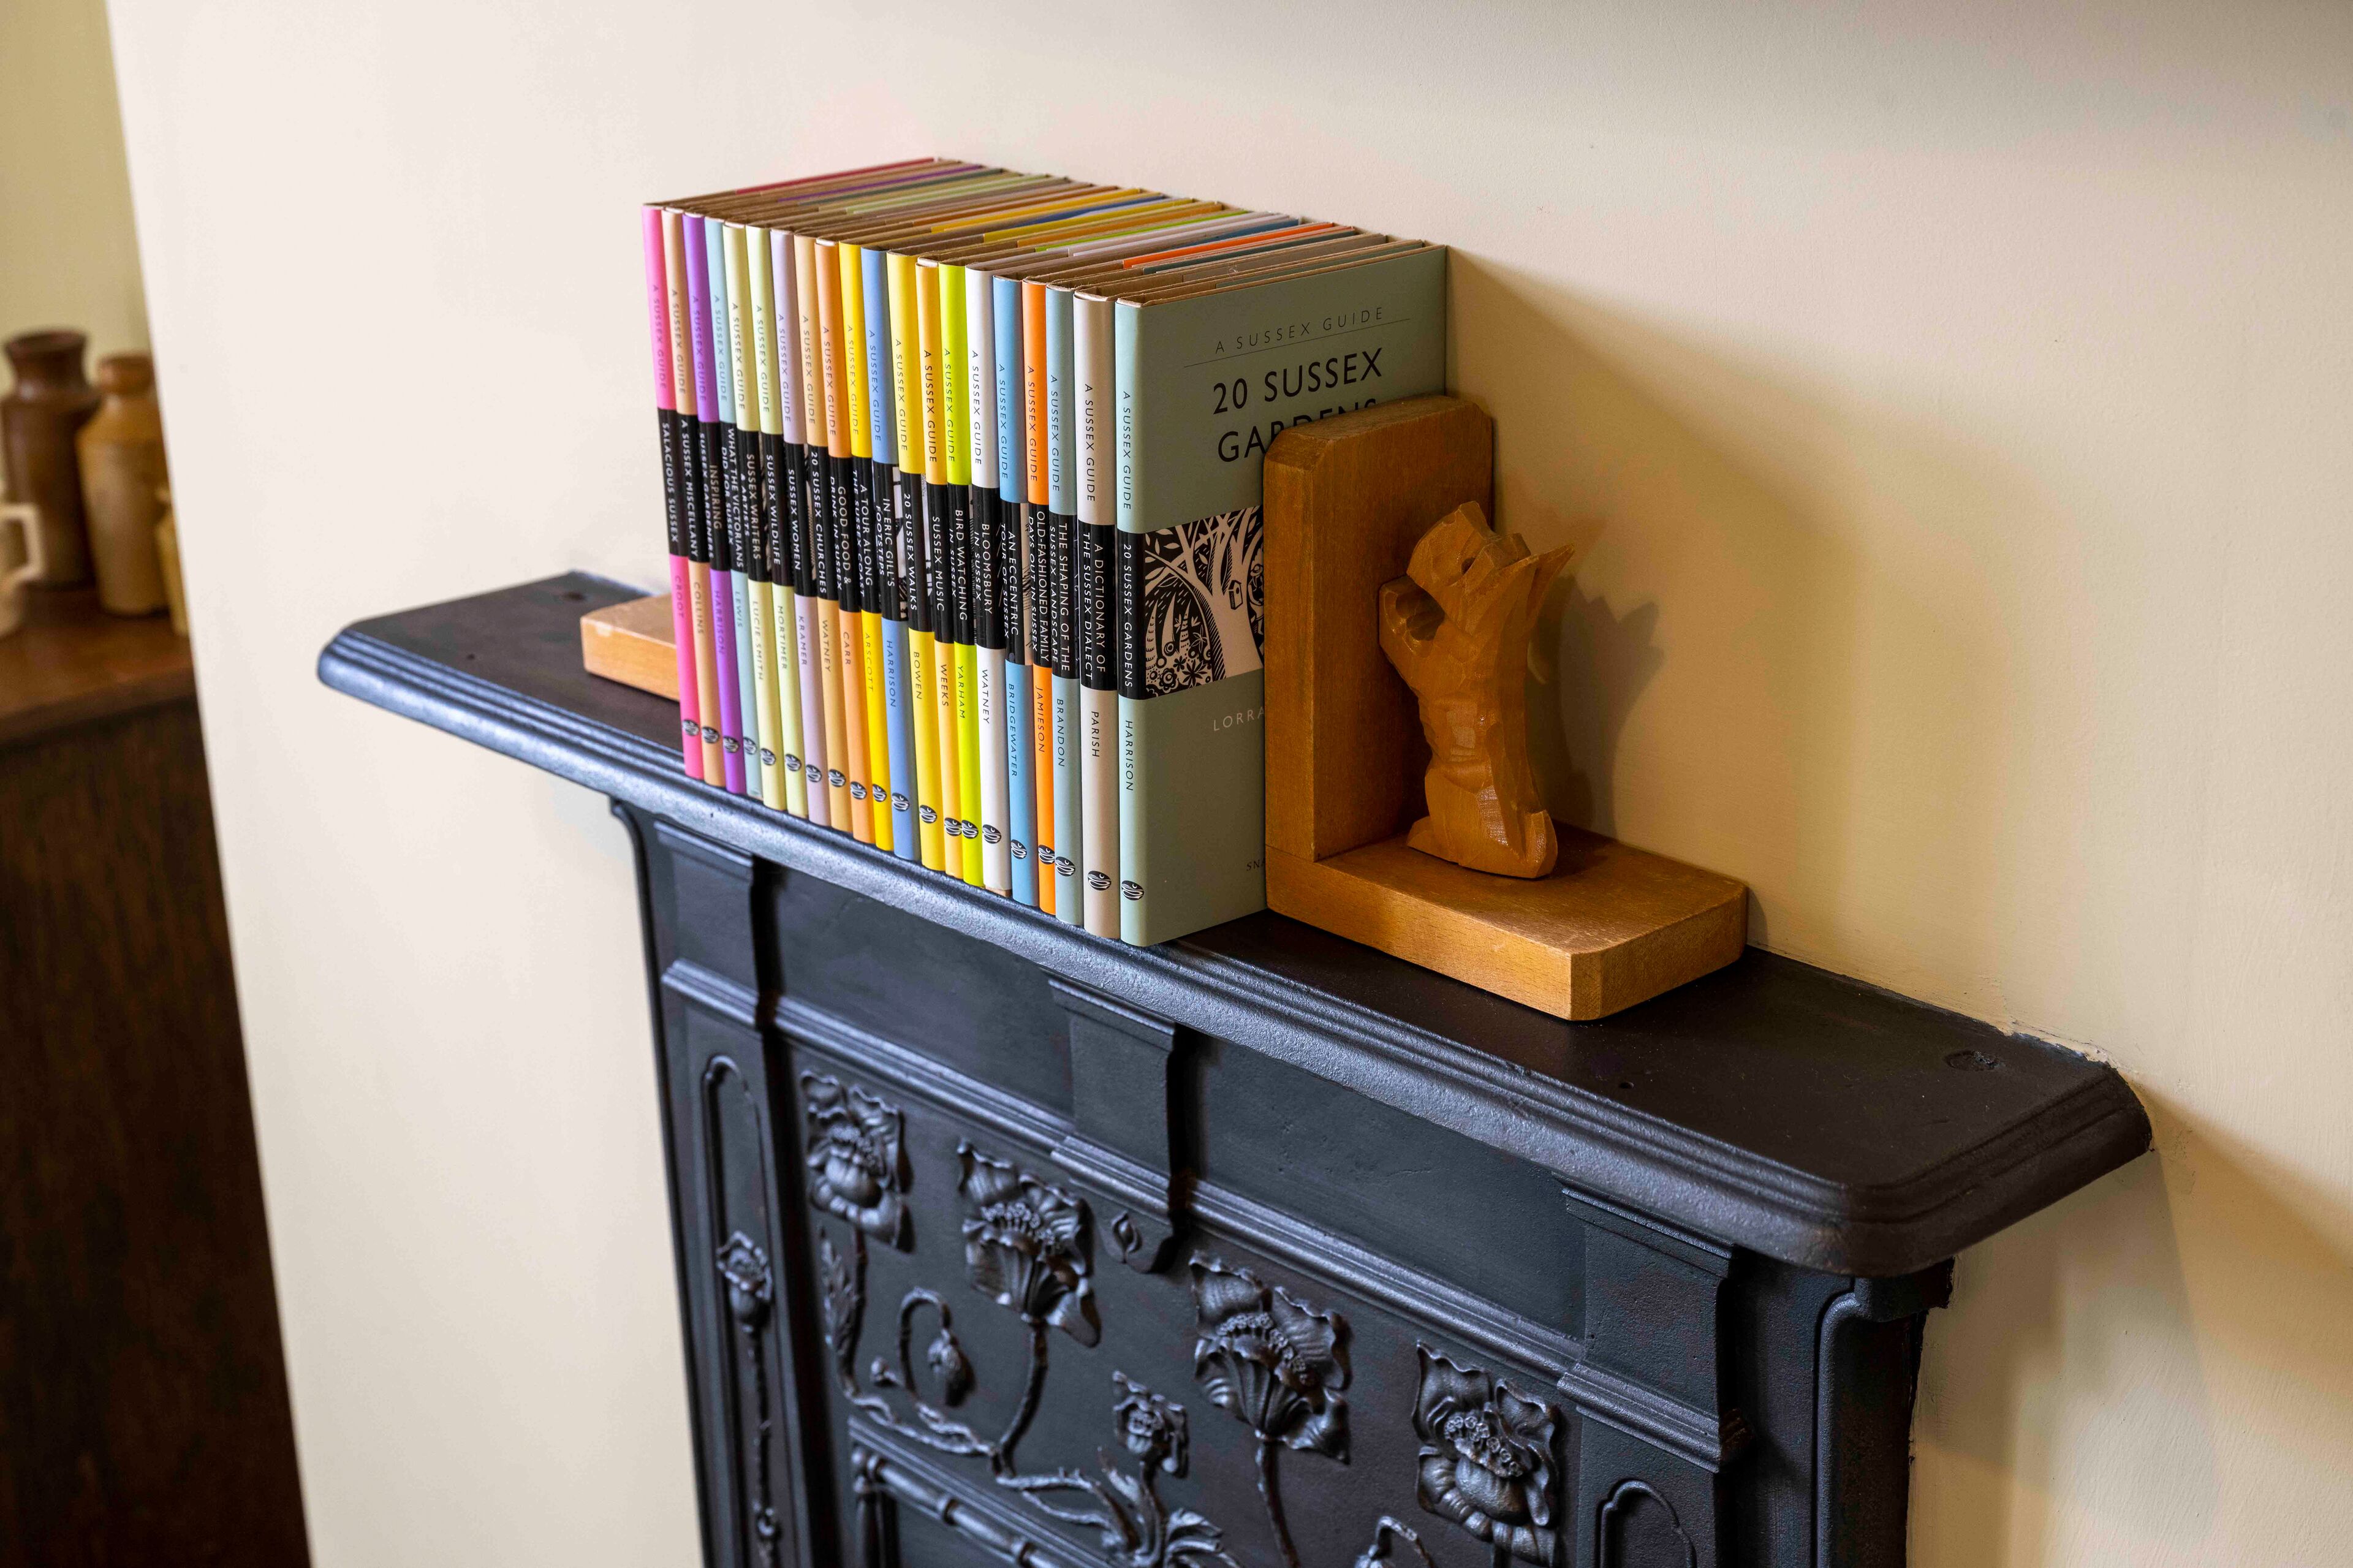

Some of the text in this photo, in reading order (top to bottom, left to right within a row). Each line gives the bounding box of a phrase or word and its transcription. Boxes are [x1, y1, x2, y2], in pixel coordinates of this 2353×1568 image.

[673, 303, 683, 349] SUSSEX
[733, 317, 743, 363] SUSSEX
[757, 319, 767, 366] SUSSEX
[803, 330, 813, 377] SUSSEX
[1215, 307, 1382, 354] A SUSSEX GUIDE
[676, 354, 686, 393] GUIDE
[736, 368, 746, 409] GUIDE
[760, 371, 770, 412] GUIDE
[778, 313, 791, 422] A SUSSEX GUIDE
[824, 341, 833, 388] SUSSEX
[868, 329, 882, 441] A SUSSEX GUIDE
[896, 354, 905, 403] SUSSEX
[944, 363, 953, 413] SUSSEX
[999, 363, 1006, 372] A
[1213, 347, 1382, 415] 20 SUSSEX
[806, 382, 816, 424] GUIDE
[827, 394, 836, 436] GUIDE
[899, 408, 908, 450] GUIDE
[923, 349, 937, 462] A SUSSEX GUIDE
[972, 350, 982, 465] A SUSSEX GUIDE
[1027, 365, 1037, 482] A SUSSEX GUIDE
[1050, 374, 1060, 491] A SUSSEX GUIDE
[947, 419, 955, 462] GUIDE
[1085, 384, 1096, 501] A SUSSEX GUIDE
[1123, 390, 1131, 510] A SUSSEX GUIDE
[662, 423, 678, 542] SALACIOUS SUSSEX
[681, 419, 699, 557] A SUSSEX MISCELLANY
[709, 464, 722, 529] INSPIRING
[727, 428, 744, 567] WHAT THE VICTORIANS
[741, 485, 750, 536] ARTISTS
[746, 453, 761, 559] SUSSEX WRITERS
[766, 454, 781, 565] SUSSEX WILDLIFE
[837, 486, 848, 528] GOOD
[703, 483, 713, 558] GARDENERS
[787, 468, 801, 570] SUSSEX WOMEN
[811, 451, 827, 593] 20 SUSSEX CHURCHES
[833, 523, 839, 539] IN
[860, 484, 873, 586] A TOUR ALONG
[876, 505, 885, 575] FOOTSTEPS
[882, 498, 895, 587] IN ERIC GILL'S
[949, 528, 954, 543] IN
[974, 531, 980, 547] IN
[841, 533, 851, 571] FOOD
[903, 493, 917, 610] 20 SUSSEX WALKS
[932, 516, 945, 612] SUSSEX MUSIC
[955, 509, 968, 621] BIRD WATCHING
[981, 523, 993, 614] BLOOMSBURY
[1002, 566, 1008, 585] OF
[694, 581, 704, 634] COLLINS
[1008, 531, 1019, 635] AN ECCENTRIC
[1030, 586, 1036, 601] IN
[1036, 510, 1049, 662] OLD-FASHIONED FAMILY
[1058, 523, 1070, 672] THE SHAPING OF THE
[1083, 564, 1092, 615] SUSSEX
[1094, 559, 1105, 648] DICTIONARY
[777, 605, 787, 669] MORTIMER
[798, 615, 808, 665] KRAMER
[822, 619, 832, 672] WATNEY
[1123, 544, 1133, 687] 20 SUSSEX GARDENS
[843, 631, 851, 665] CARR
[865, 632, 874, 692] ARSCOTT
[886, 640, 896, 708] HARRISON
[913, 651, 922, 700] BOWEN
[1084, 621, 1093, 681] DIALECT
[1096, 654, 1106, 672] OF
[940, 664, 949, 706] WEEKS
[957, 665, 966, 719] YARHAM
[1008, 683, 1018, 776] BRIDGEWATER
[1035, 686, 1045, 752] JAMIESON
[1056, 698, 1065, 767] BRANDON
[1091, 711, 1100, 757] PARISH
[1214, 706, 1265, 731] LORRA
[1125, 720, 1134, 791] HARRISON
